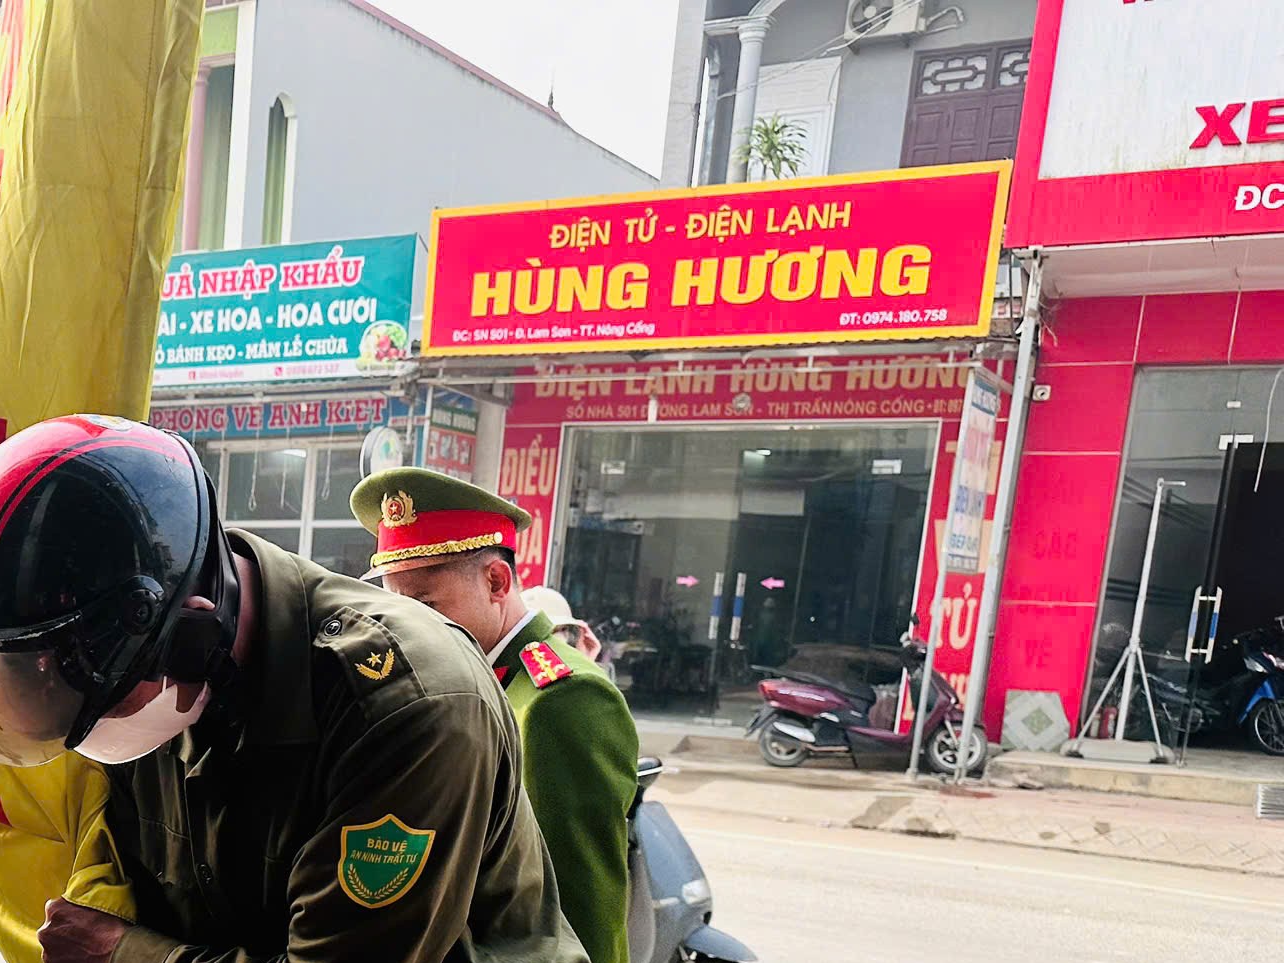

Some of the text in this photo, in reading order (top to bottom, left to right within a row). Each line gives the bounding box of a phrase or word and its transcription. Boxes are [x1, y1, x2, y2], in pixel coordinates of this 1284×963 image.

[1189, 98, 1284, 149] XE
[550, 216, 611, 252] ĐIỆN
[624, 208, 658, 243] TỬ
[685, 205, 753, 244] ĐIỆN
[767, 202, 852, 236] LẠNH
[199, 258, 277, 300] NHẬP
[279, 245, 365, 291] KHẨU
[471, 244, 932, 318] HÙNG HƯƠNG
[190, 310, 214, 334] XE
[217, 307, 262, 333] HOA
[277, 302, 323, 328] HOA
[327, 297, 377, 325] CƯỚI
[167, 343, 205, 364] BÁNH
[206, 344, 236, 366] KẸO
[566, 400, 584, 419] SỐ
[587, 401, 613, 418] NHÀ
[617, 405, 637, 418] 501
[641, 403, 688, 418] ĐỜNG
[692, 402, 721, 416] LAM
[767, 401, 789, 419] THỊ
[794, 396, 833, 416] TRẤN
[833, 397, 877, 415] NÔNG
[881, 394, 925, 414] CỐNG
[500, 434, 556, 496] ĐIỀU
[367, 836, 407, 855] BẢO VỆ
